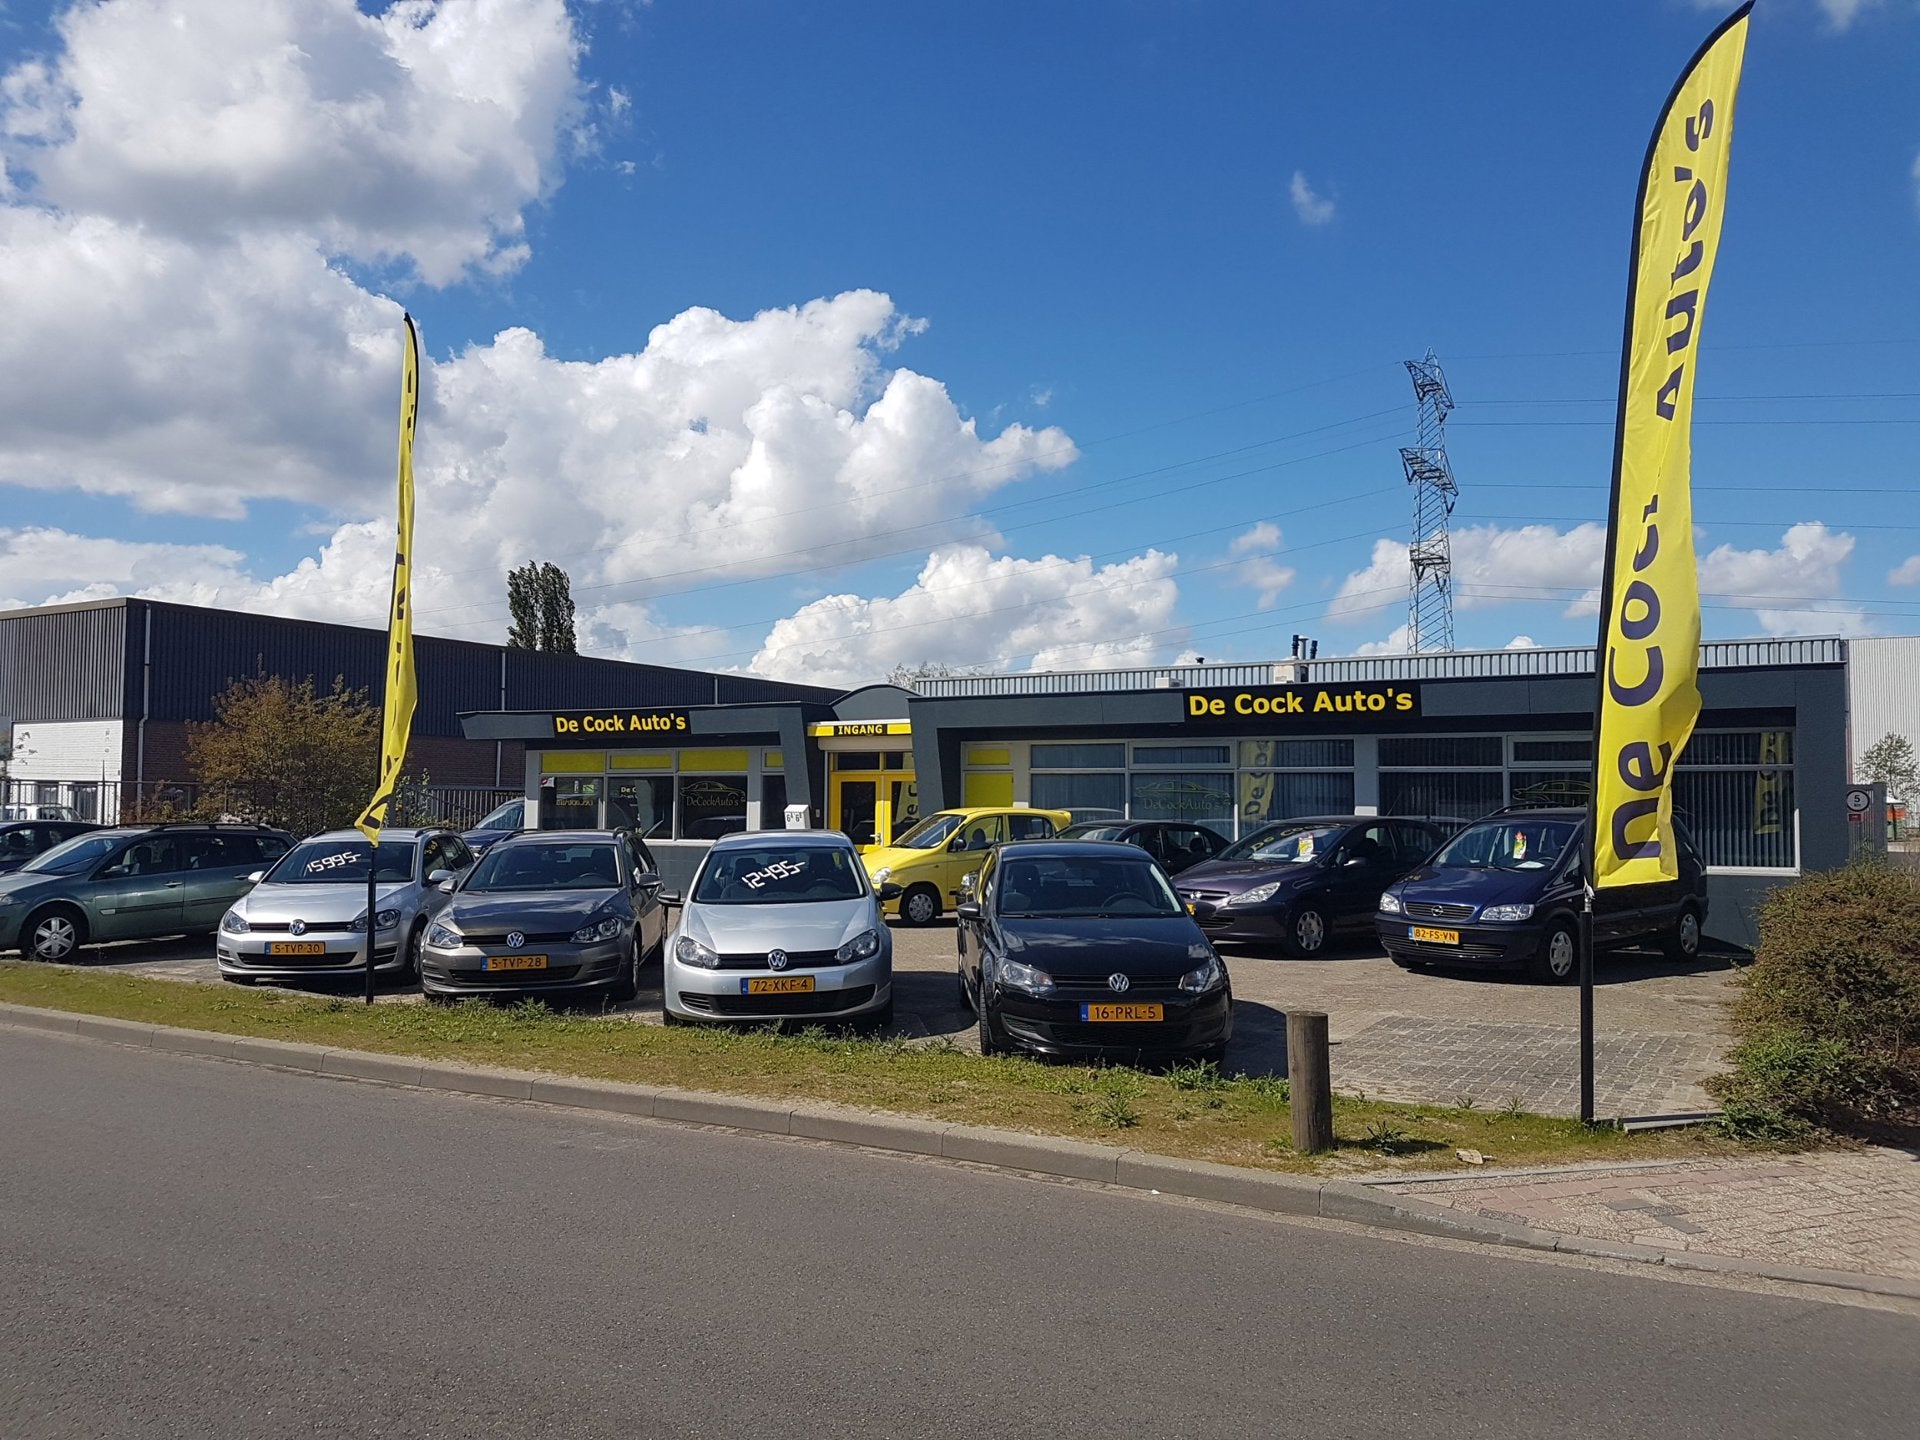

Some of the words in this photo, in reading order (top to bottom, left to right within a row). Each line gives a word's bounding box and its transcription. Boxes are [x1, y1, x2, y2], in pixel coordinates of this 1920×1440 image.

[1189, 695, 1226, 716] De
[1234, 691, 1304, 715] Cock
[1313, 688, 1414, 713] Auto's
[555, 717, 579, 733] De
[583, 714, 625, 732] Cock
[630, 713, 686, 731] Auto's
[838, 725, 883, 735] INGANG
[1854, 794, 1861, 803] 5
[1415, 928, 1456, 942] 82-FS-VN
[274, 944, 320, 954] 5-TVP-30
[491, 957, 542, 969] 5-TVP-28
[752, 979, 808, 992] 72-XKF-4
[1095, 1006, 1156, 1020] 16-PRL-5
